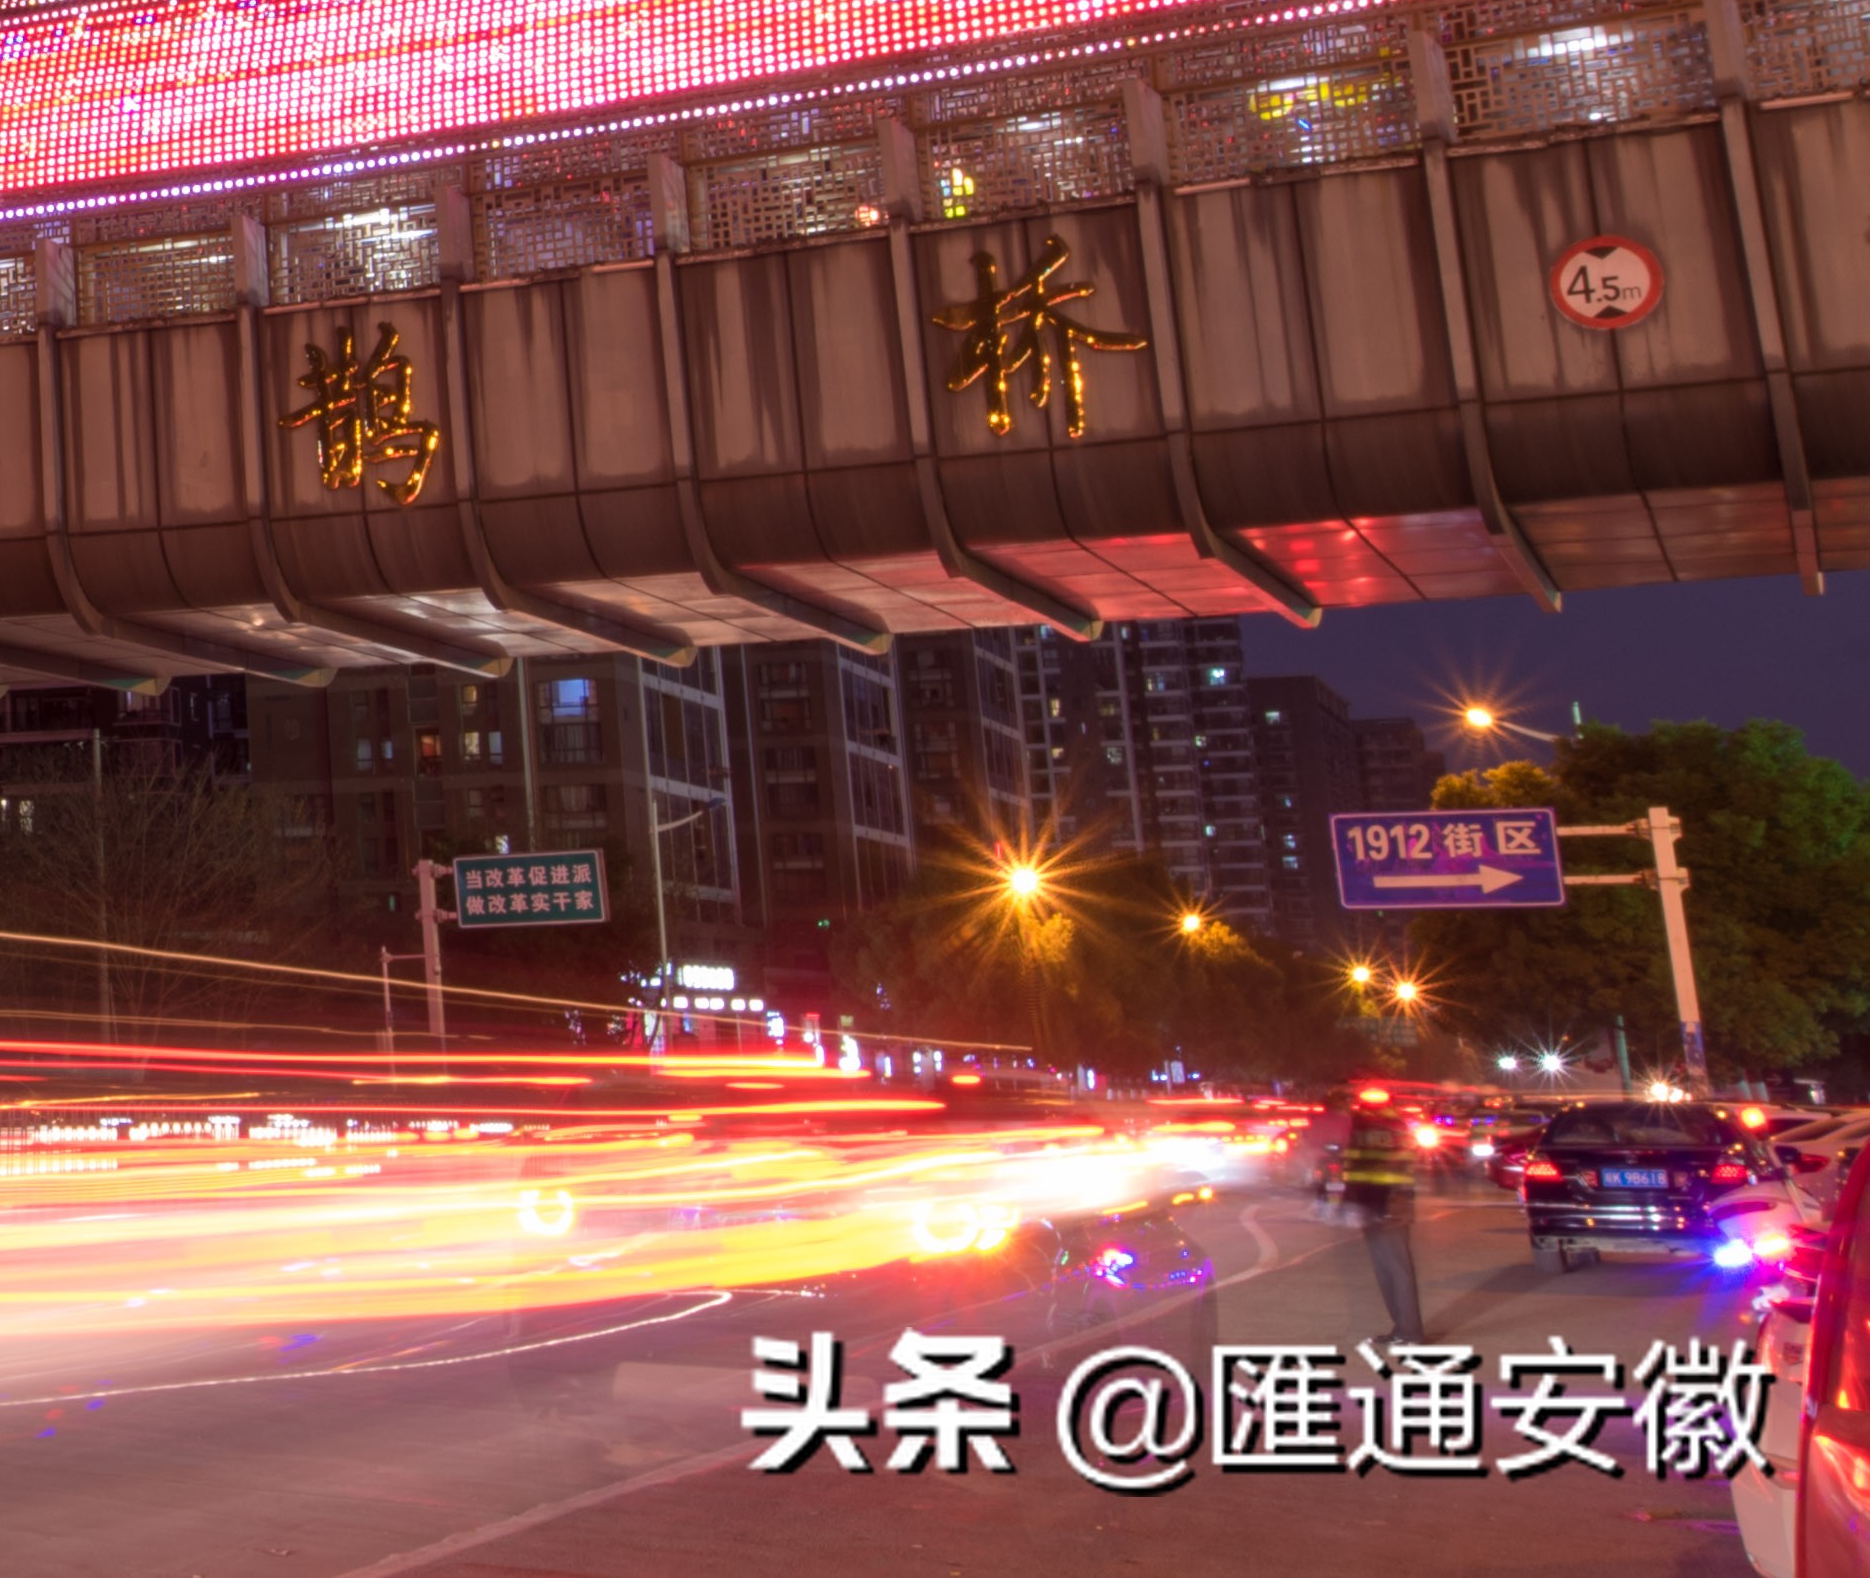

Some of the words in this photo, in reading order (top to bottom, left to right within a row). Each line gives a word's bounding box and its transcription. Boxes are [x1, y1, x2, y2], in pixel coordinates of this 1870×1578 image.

[1566, 265, 1642, 306] 4.5m
[1347, 822, 1432, 861] 1912
[1441, 820, 1543, 858] 街区
[464, 862, 594, 891] 当改革促进派
[465, 889, 595, 917] 做改革实干家
